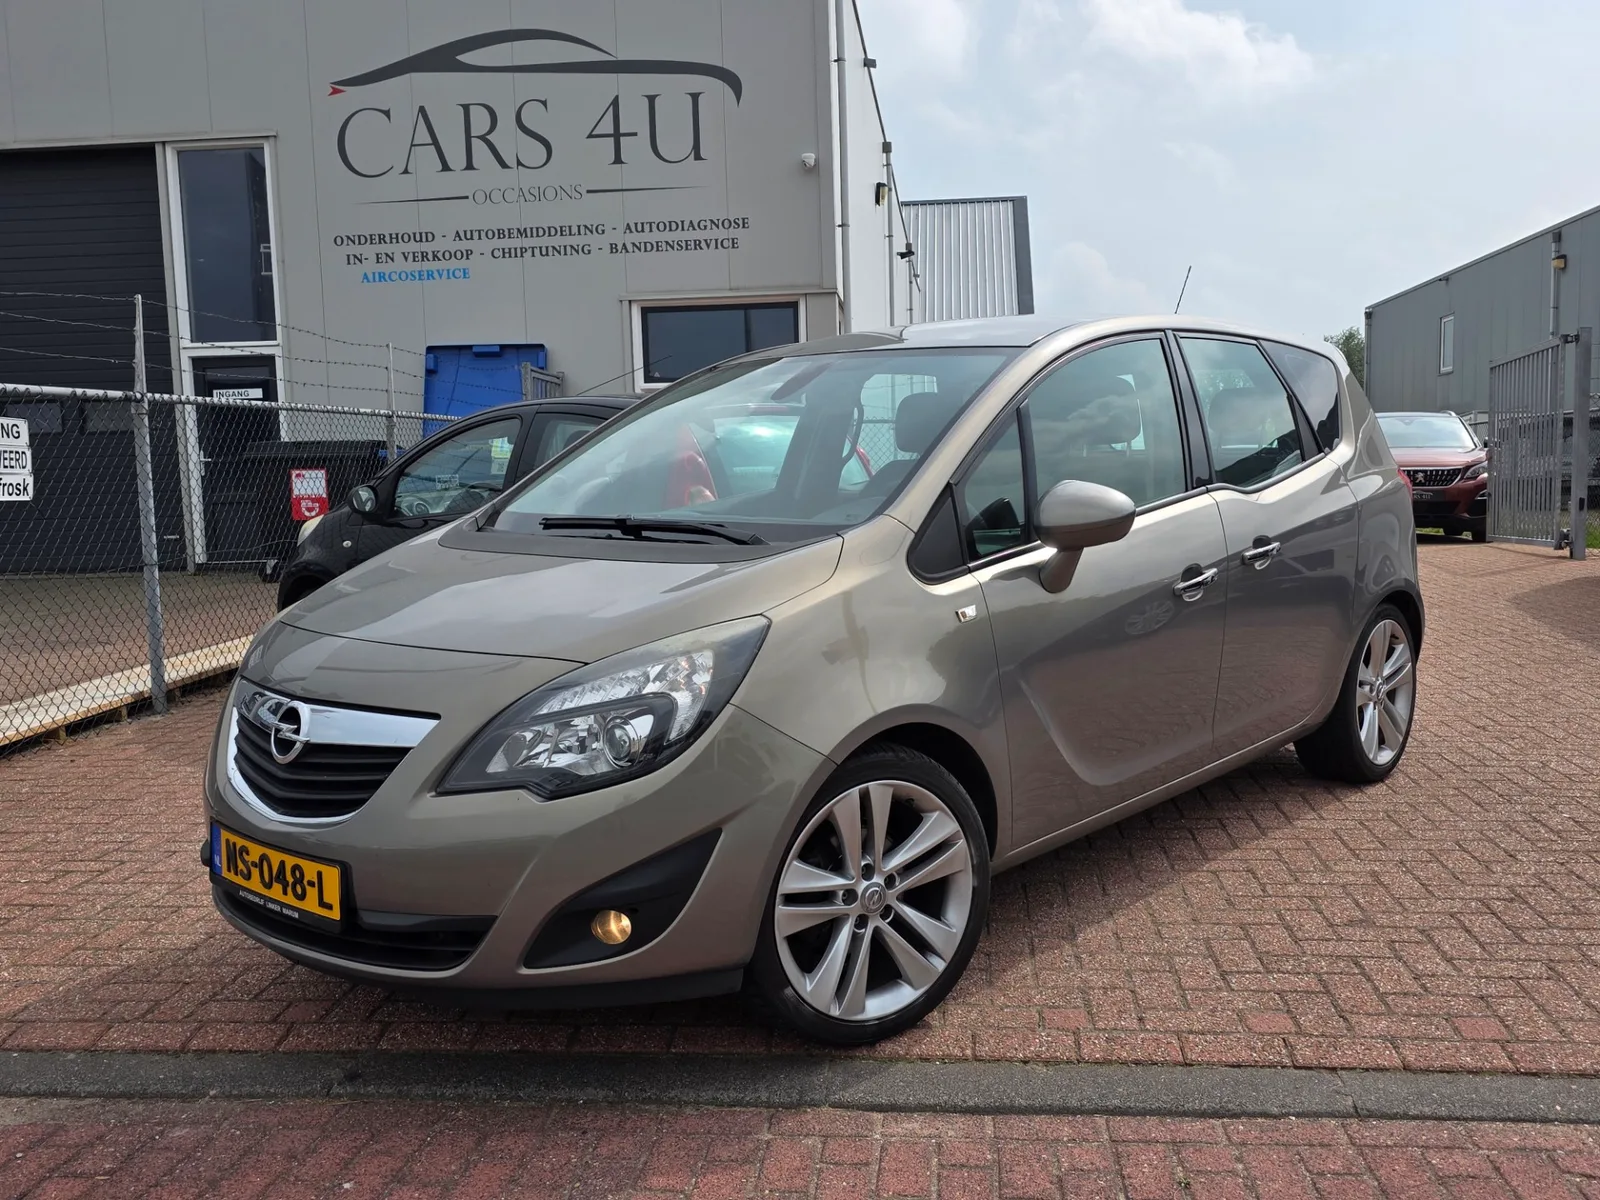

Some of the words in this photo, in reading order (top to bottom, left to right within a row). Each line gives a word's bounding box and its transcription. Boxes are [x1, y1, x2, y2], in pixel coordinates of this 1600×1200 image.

[337, 98, 553, 178] CARS
[586, 91, 709, 166] 4U
[472, 184, 583, 205] OCCASIONS
[333, 231, 435, 247] ONDERHOUD
[453, 223, 606, 242] AUTOBEMIDDELING
[624, 217, 750, 234] AUTODIAGNOSE
[346, 254, 369, 266] IN-
[375, 252, 395, 264] EN
[401, 249, 474, 263] VERKOOP
[490, 243, 592, 260] CHIPTUNING
[609, 237, 740, 254] BANDENSERVICE
[361, 267, 470, 283] AIRCOSERVICE
[215, 389, 250, 399] INGANG
[214, 853, 222, 867] NL
[225, 838, 333, 911] NS-048-L
